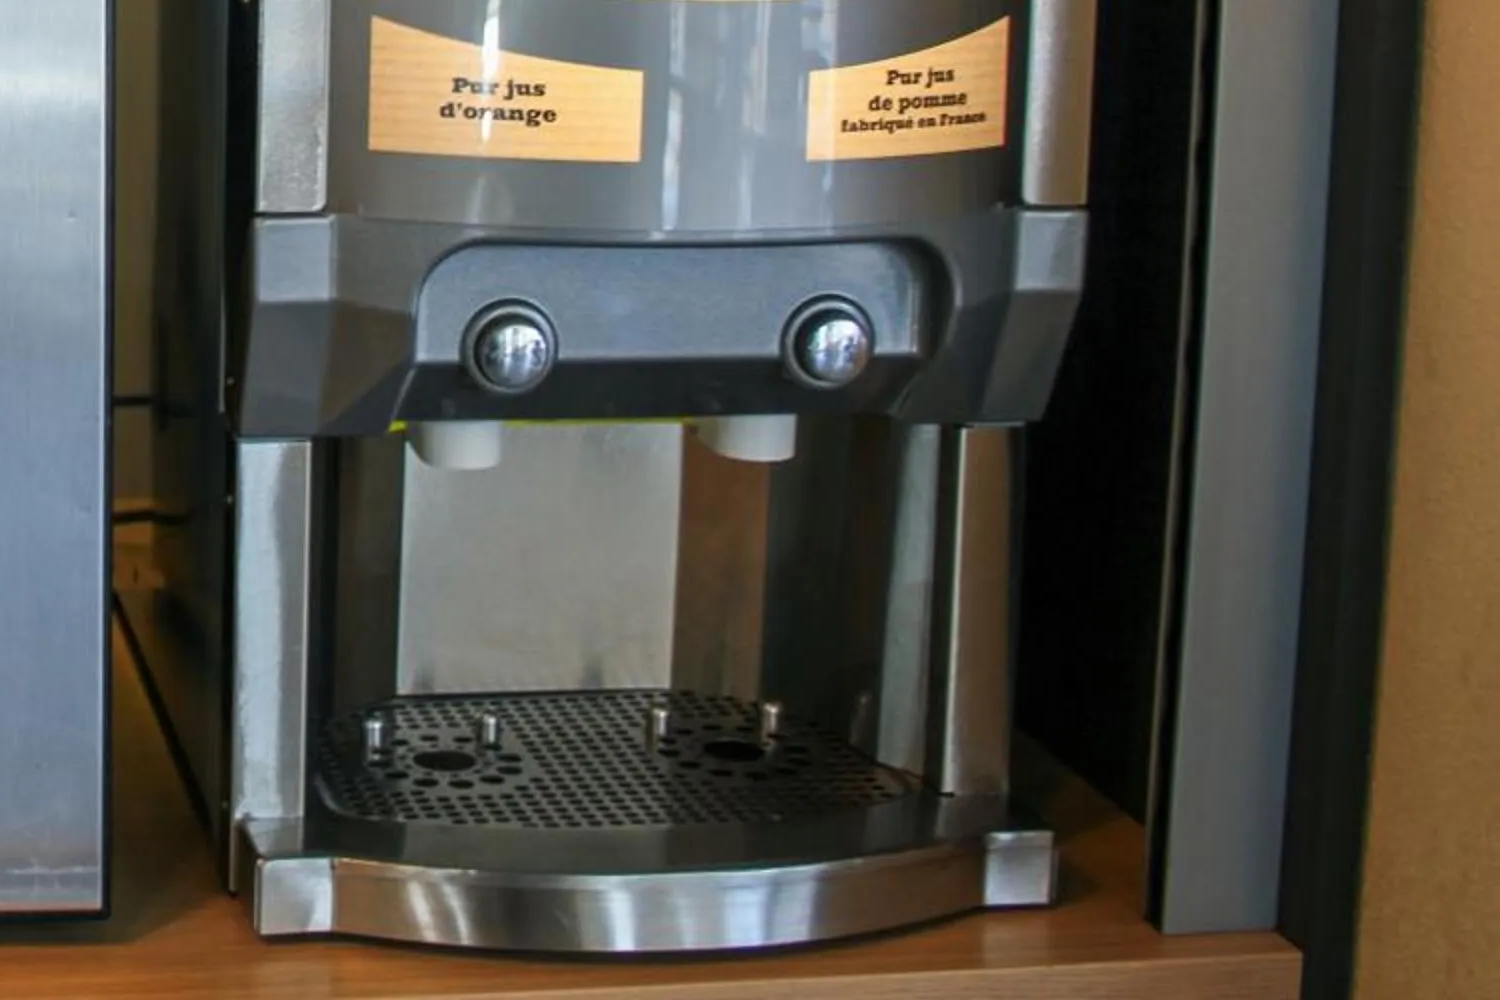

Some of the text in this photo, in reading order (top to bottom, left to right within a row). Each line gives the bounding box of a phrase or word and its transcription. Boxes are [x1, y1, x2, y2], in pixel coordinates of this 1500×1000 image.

[451, 76, 546, 100] Pur jus
[886, 67, 955, 88] Pur jus
[439, 102, 557, 127] d'orange
[868, 92, 967, 114] de pomme
[841, 111, 987, 134] fabriqué en France
